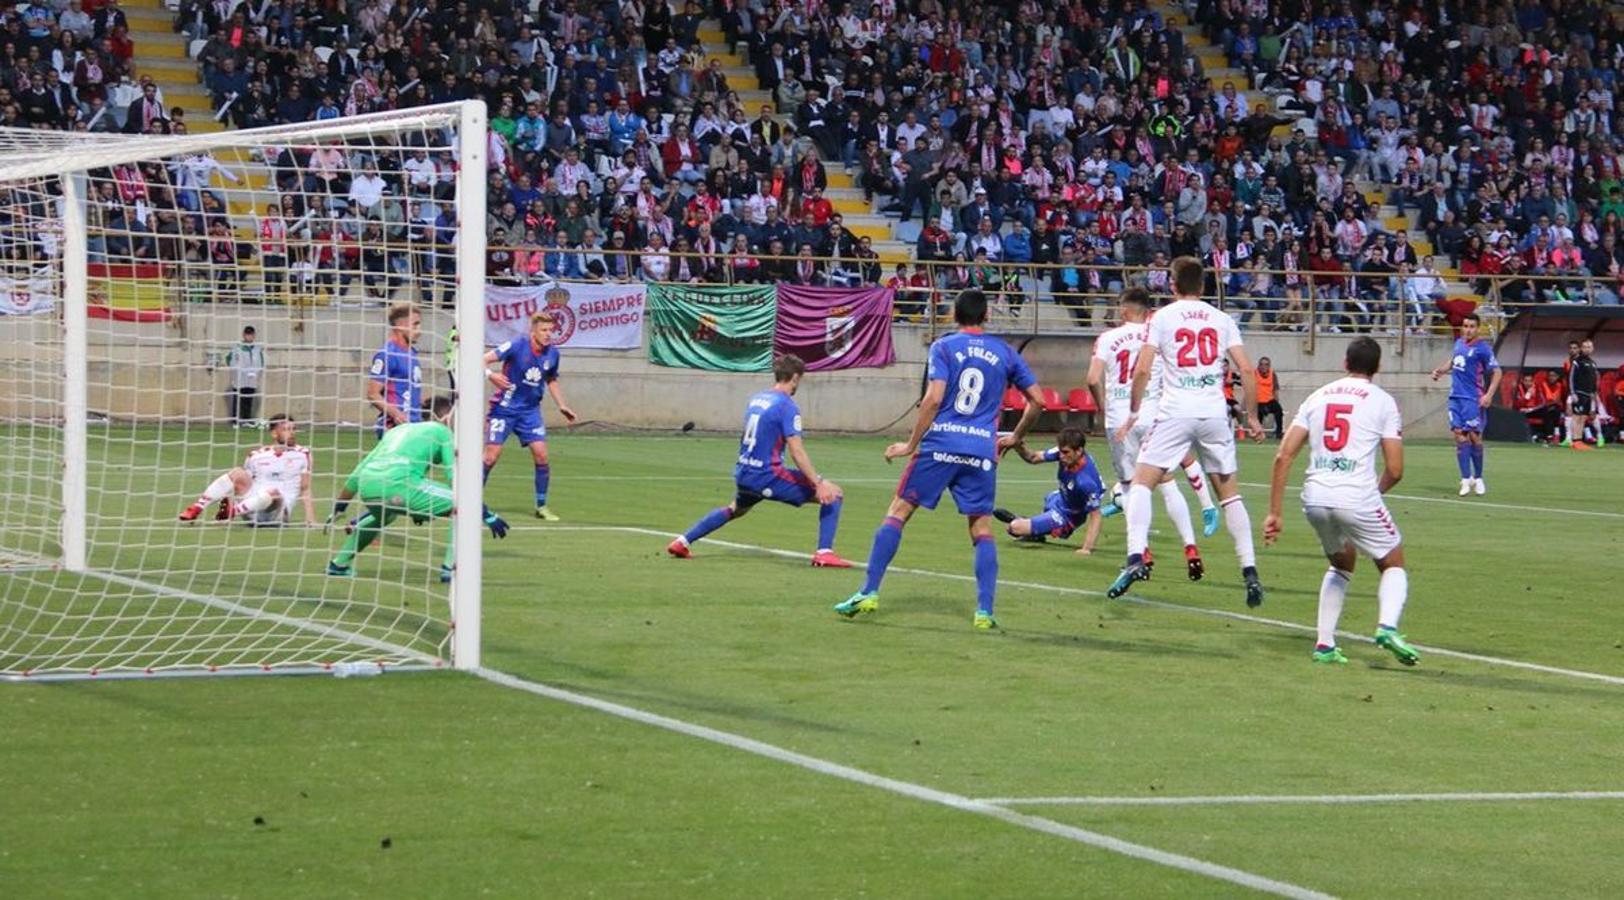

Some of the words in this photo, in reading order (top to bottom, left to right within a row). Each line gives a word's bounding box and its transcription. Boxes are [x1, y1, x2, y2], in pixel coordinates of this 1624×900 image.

[486, 298, 537, 321] ULTU
[579, 293, 643, 316] SIEMPRE
[578, 312, 640, 331] CONTIGO
[968, 345, 999, 366] FOLCH
[1175, 327, 1218, 368] 20
[1116, 348, 1141, 384] 1
[954, 367, 985, 415] 8
[490, 418, 506, 432] 23
[743, 413, 760, 452] 4
[1323, 403, 1354, 452] 5
